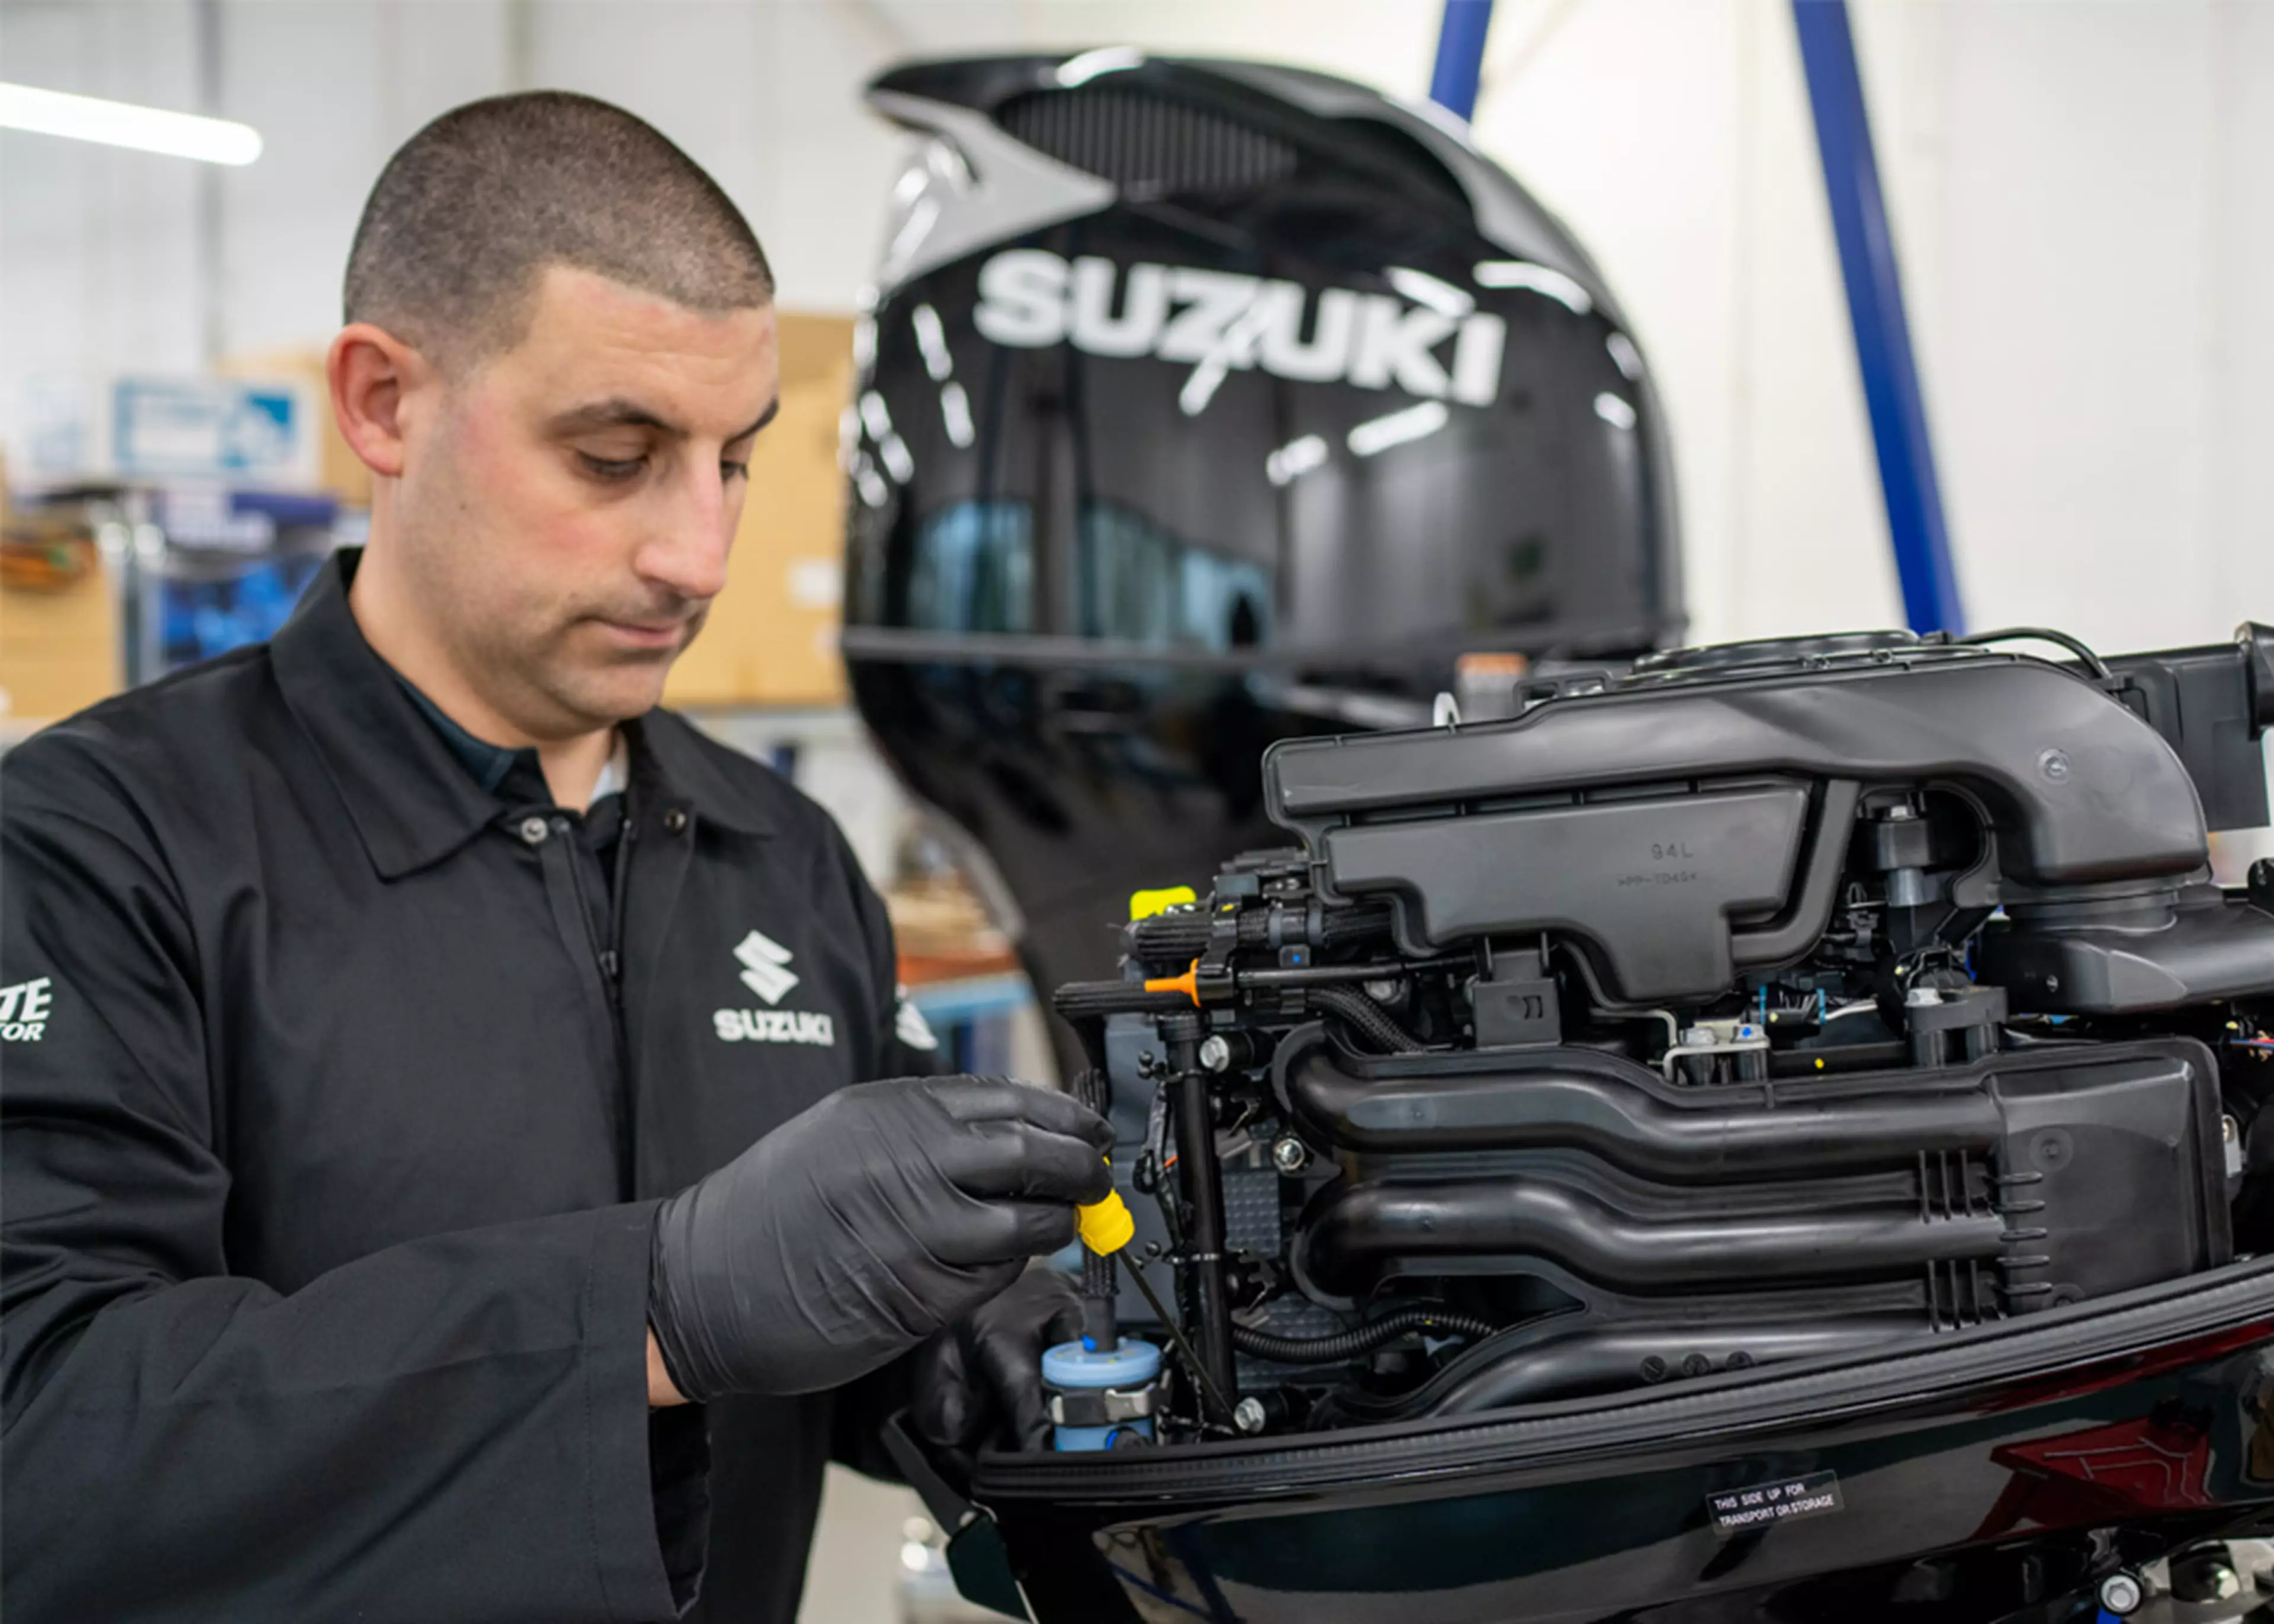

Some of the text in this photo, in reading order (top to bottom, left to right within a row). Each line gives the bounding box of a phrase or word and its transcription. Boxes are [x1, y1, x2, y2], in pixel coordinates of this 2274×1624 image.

[973, 249, 1506, 406] SUZUKI
[0, 977, 52, 1021] TE
[713, 1008, 834, 1046] SUZUKI
[1714, 1482, 1805, 1510] THIS SIDE UP FOR
[1719, 1494, 1834, 1527] TRANSPORT OR STORAGE
